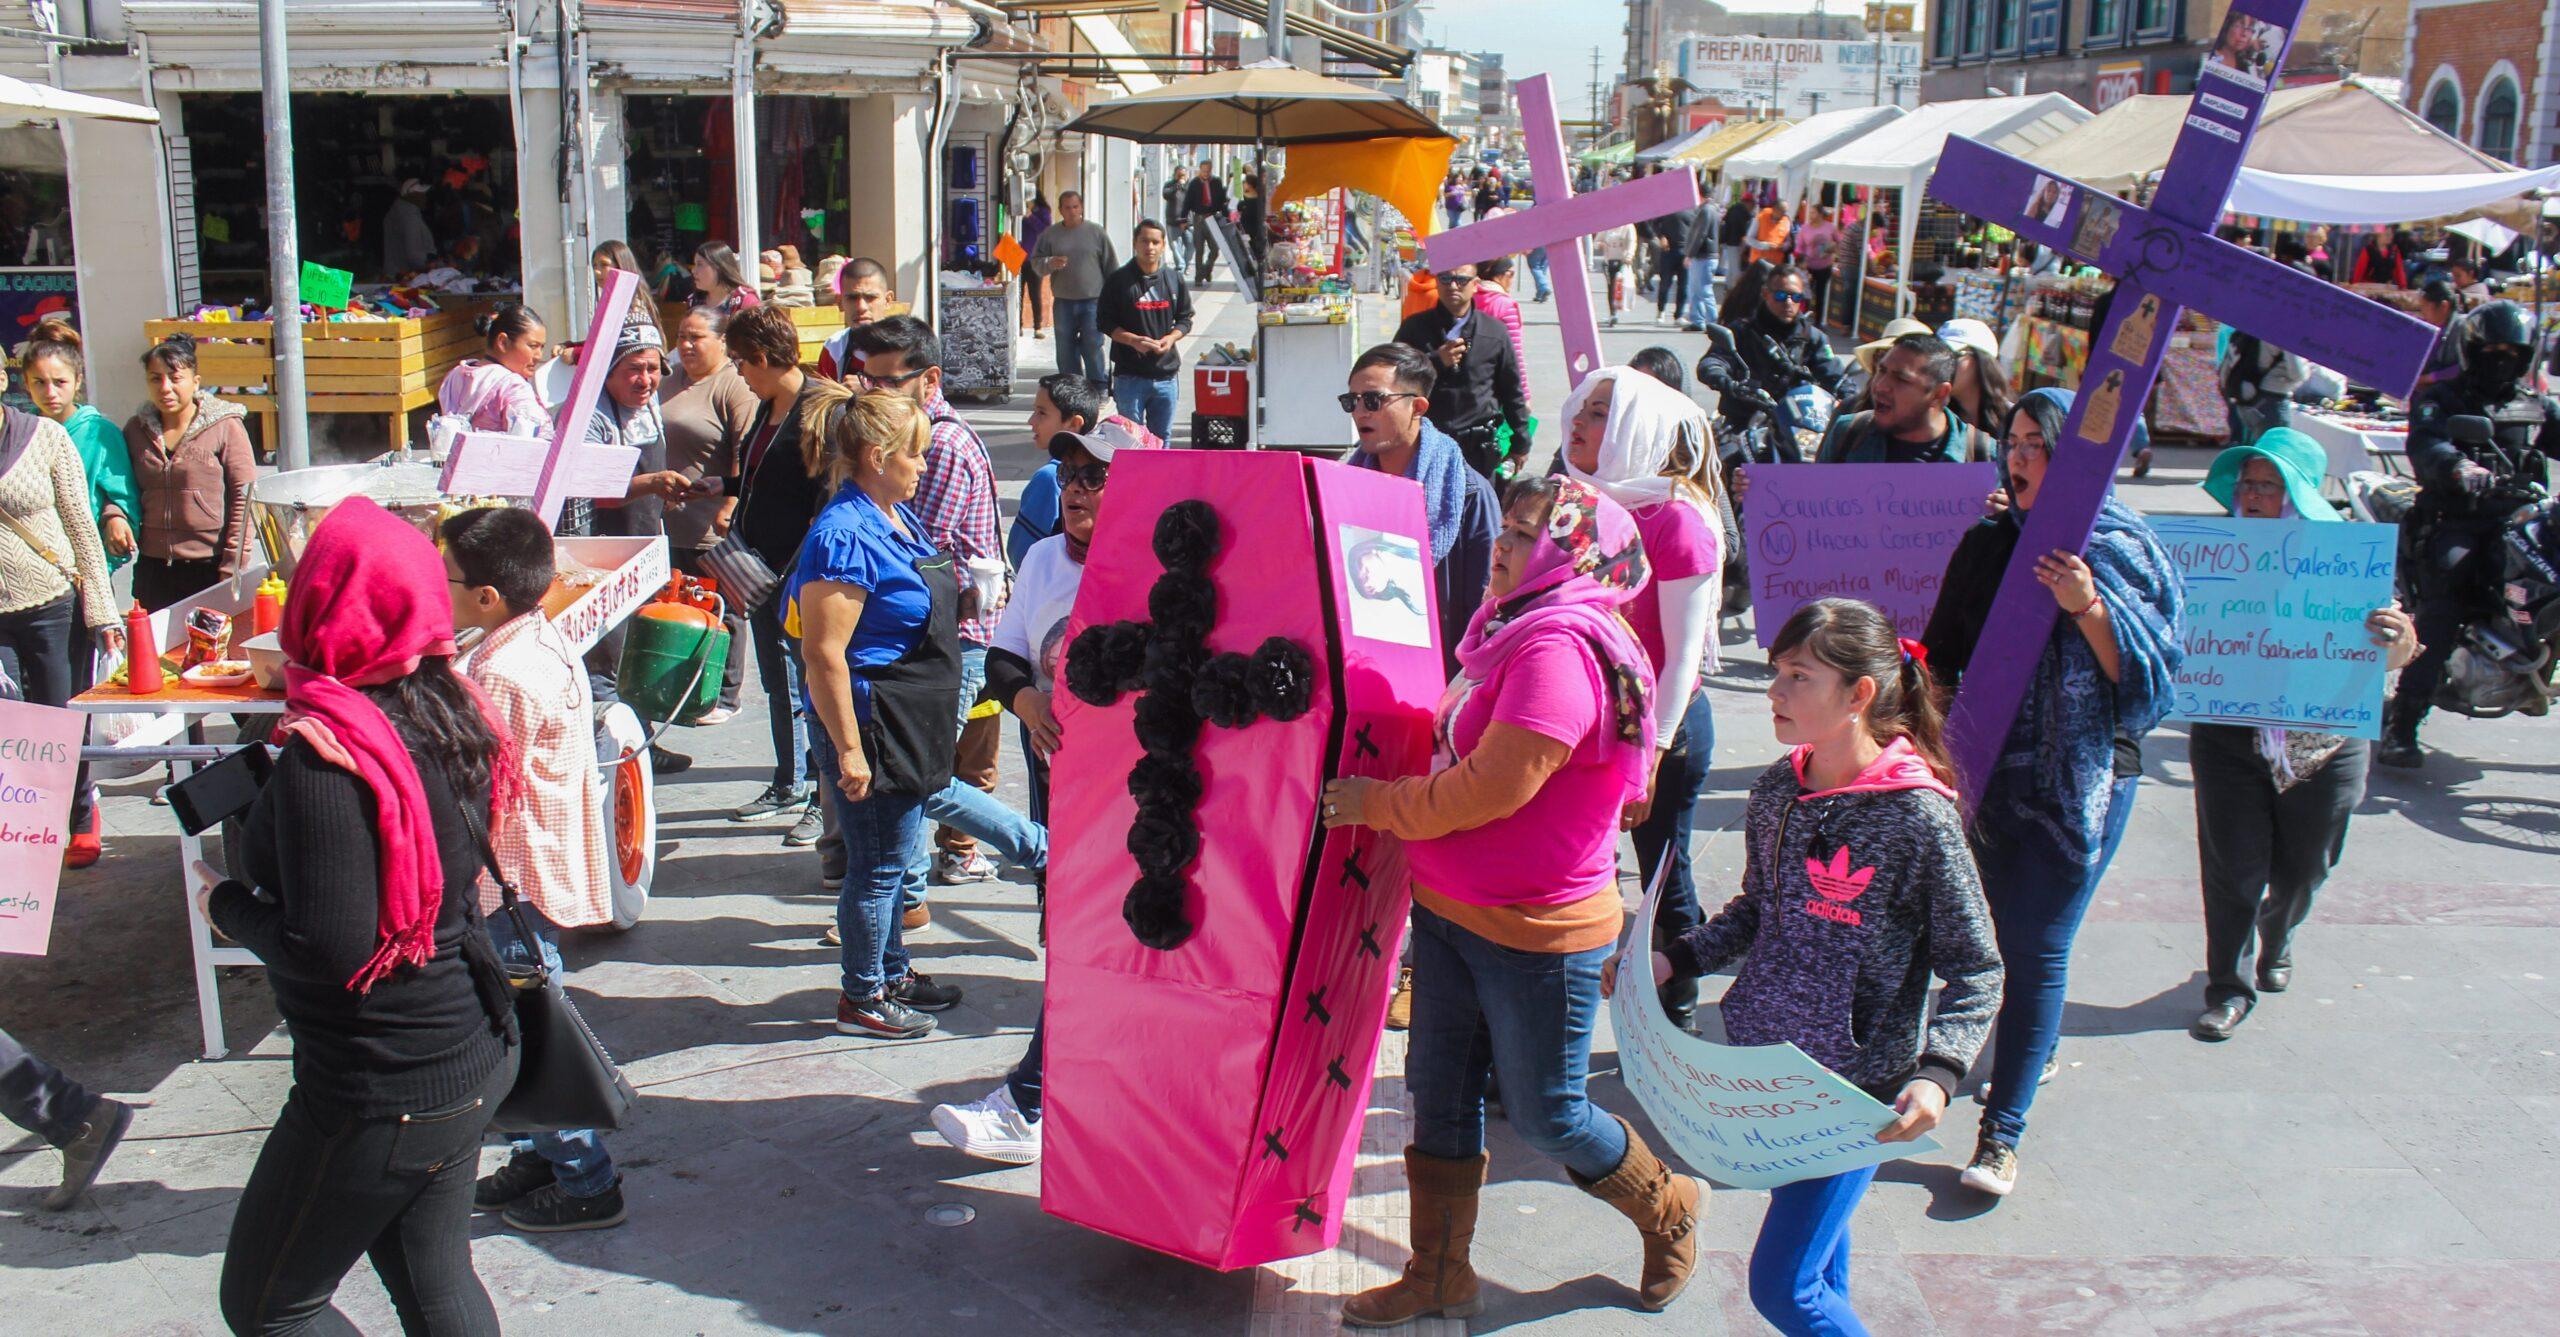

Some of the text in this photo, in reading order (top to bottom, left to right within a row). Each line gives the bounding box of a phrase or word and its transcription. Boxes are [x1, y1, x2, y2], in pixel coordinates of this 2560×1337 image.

[1696, 41, 1823, 64] PREPARATORIA
[2203, 96, 2245, 116] IMPUNIDAD
[1766, 531, 1792, 555] NO
[1807, 527, 1868, 551] HACEN
[2360, 541, 2392, 578] Tec
[1764, 572, 1871, 600] Encuentra
[2220, 599, 2266, 619] para
[2275, 589, 2292, 617] la
[2257, 628, 2319, 661] Gabriela
[2304, 702, 2372, 722] respuesta
[1806, 900, 1861, 926] adidas
[1743, 1118, 1871, 1151] MUJERES
